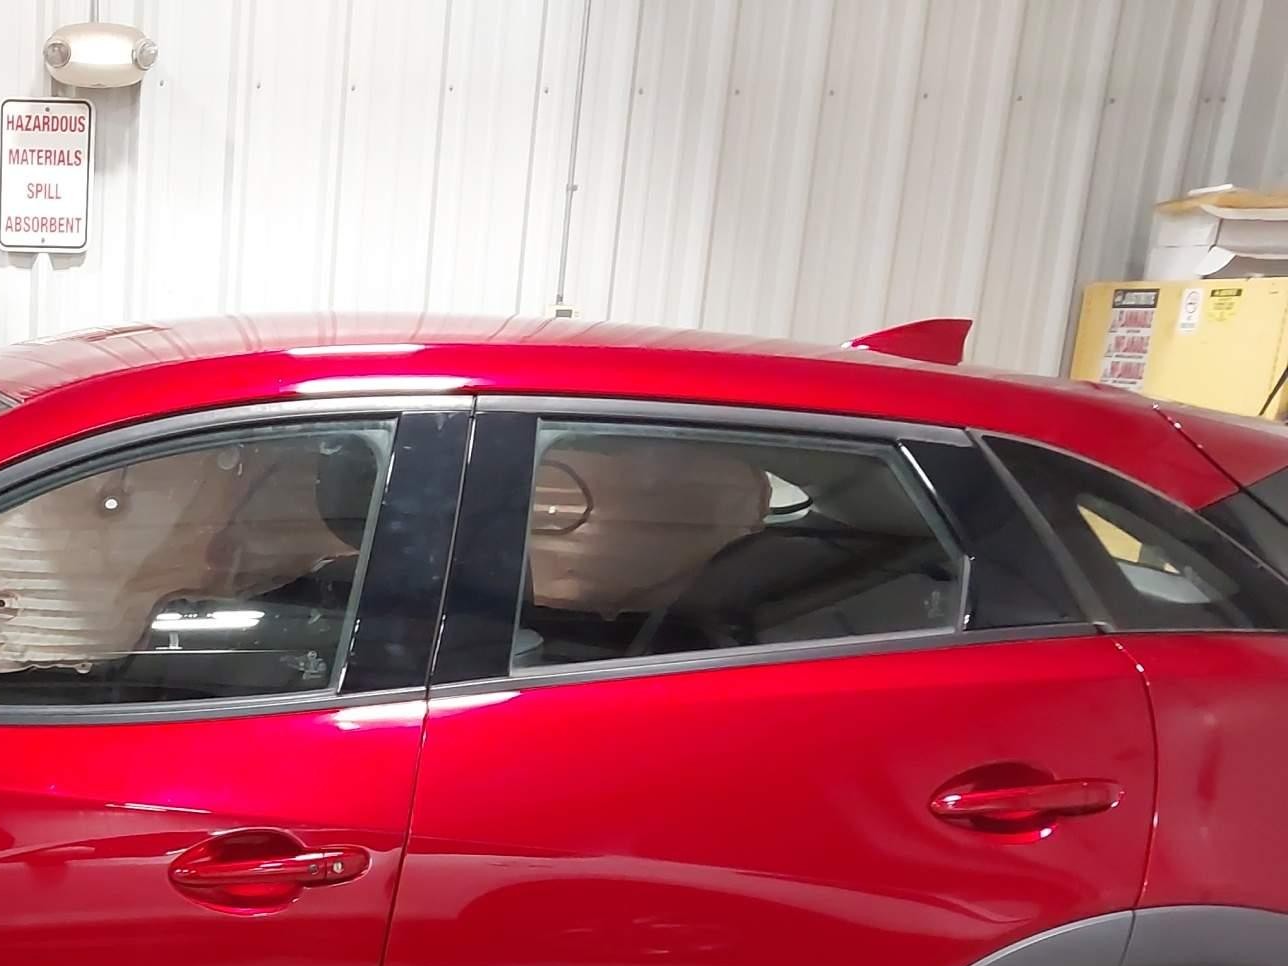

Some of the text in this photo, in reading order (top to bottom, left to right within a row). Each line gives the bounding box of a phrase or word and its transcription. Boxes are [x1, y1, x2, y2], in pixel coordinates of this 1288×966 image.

[6, 115, 86, 133] HAZARDOUS
[8, 149, 82, 166] MATERIALS
[26, 182, 62, 200] SPILL
[5, 216, 82, 233] ABSORBENT
